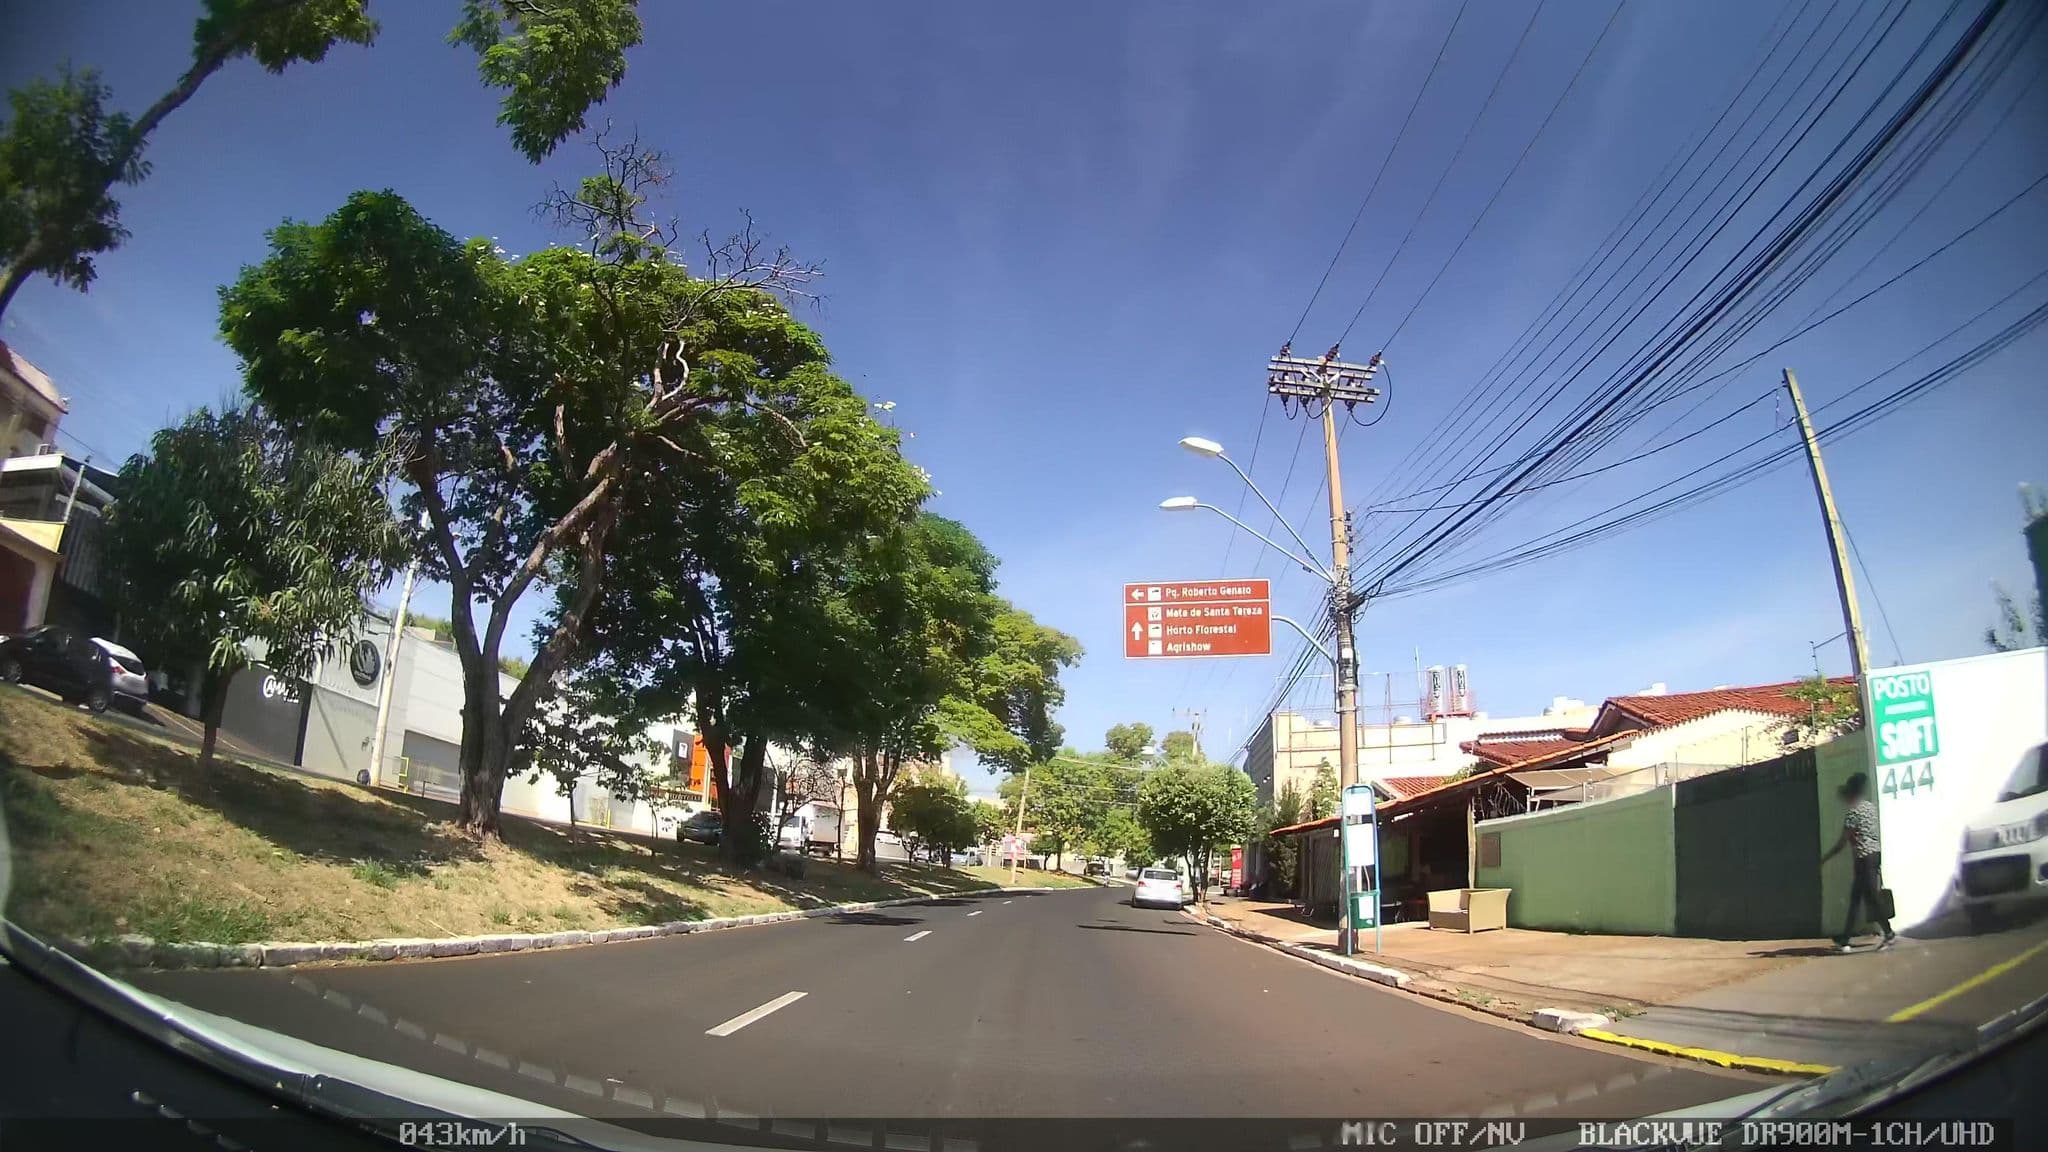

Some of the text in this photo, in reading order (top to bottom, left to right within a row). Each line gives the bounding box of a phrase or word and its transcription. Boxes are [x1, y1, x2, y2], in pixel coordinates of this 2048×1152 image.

[1182, 587, 1217, 597] Roberto
[1166, 608, 1188, 618] Mata
[1190, 608, 1201, 617] de
[1203, 607, 1230, 617] Santa
[1166, 624, 1237, 635] Horto Florestal
[1167, 641, 1211, 653] Agrishow
[1872, 674, 1930, 700] POSTO
[1882, 761, 1935, 799] 444
